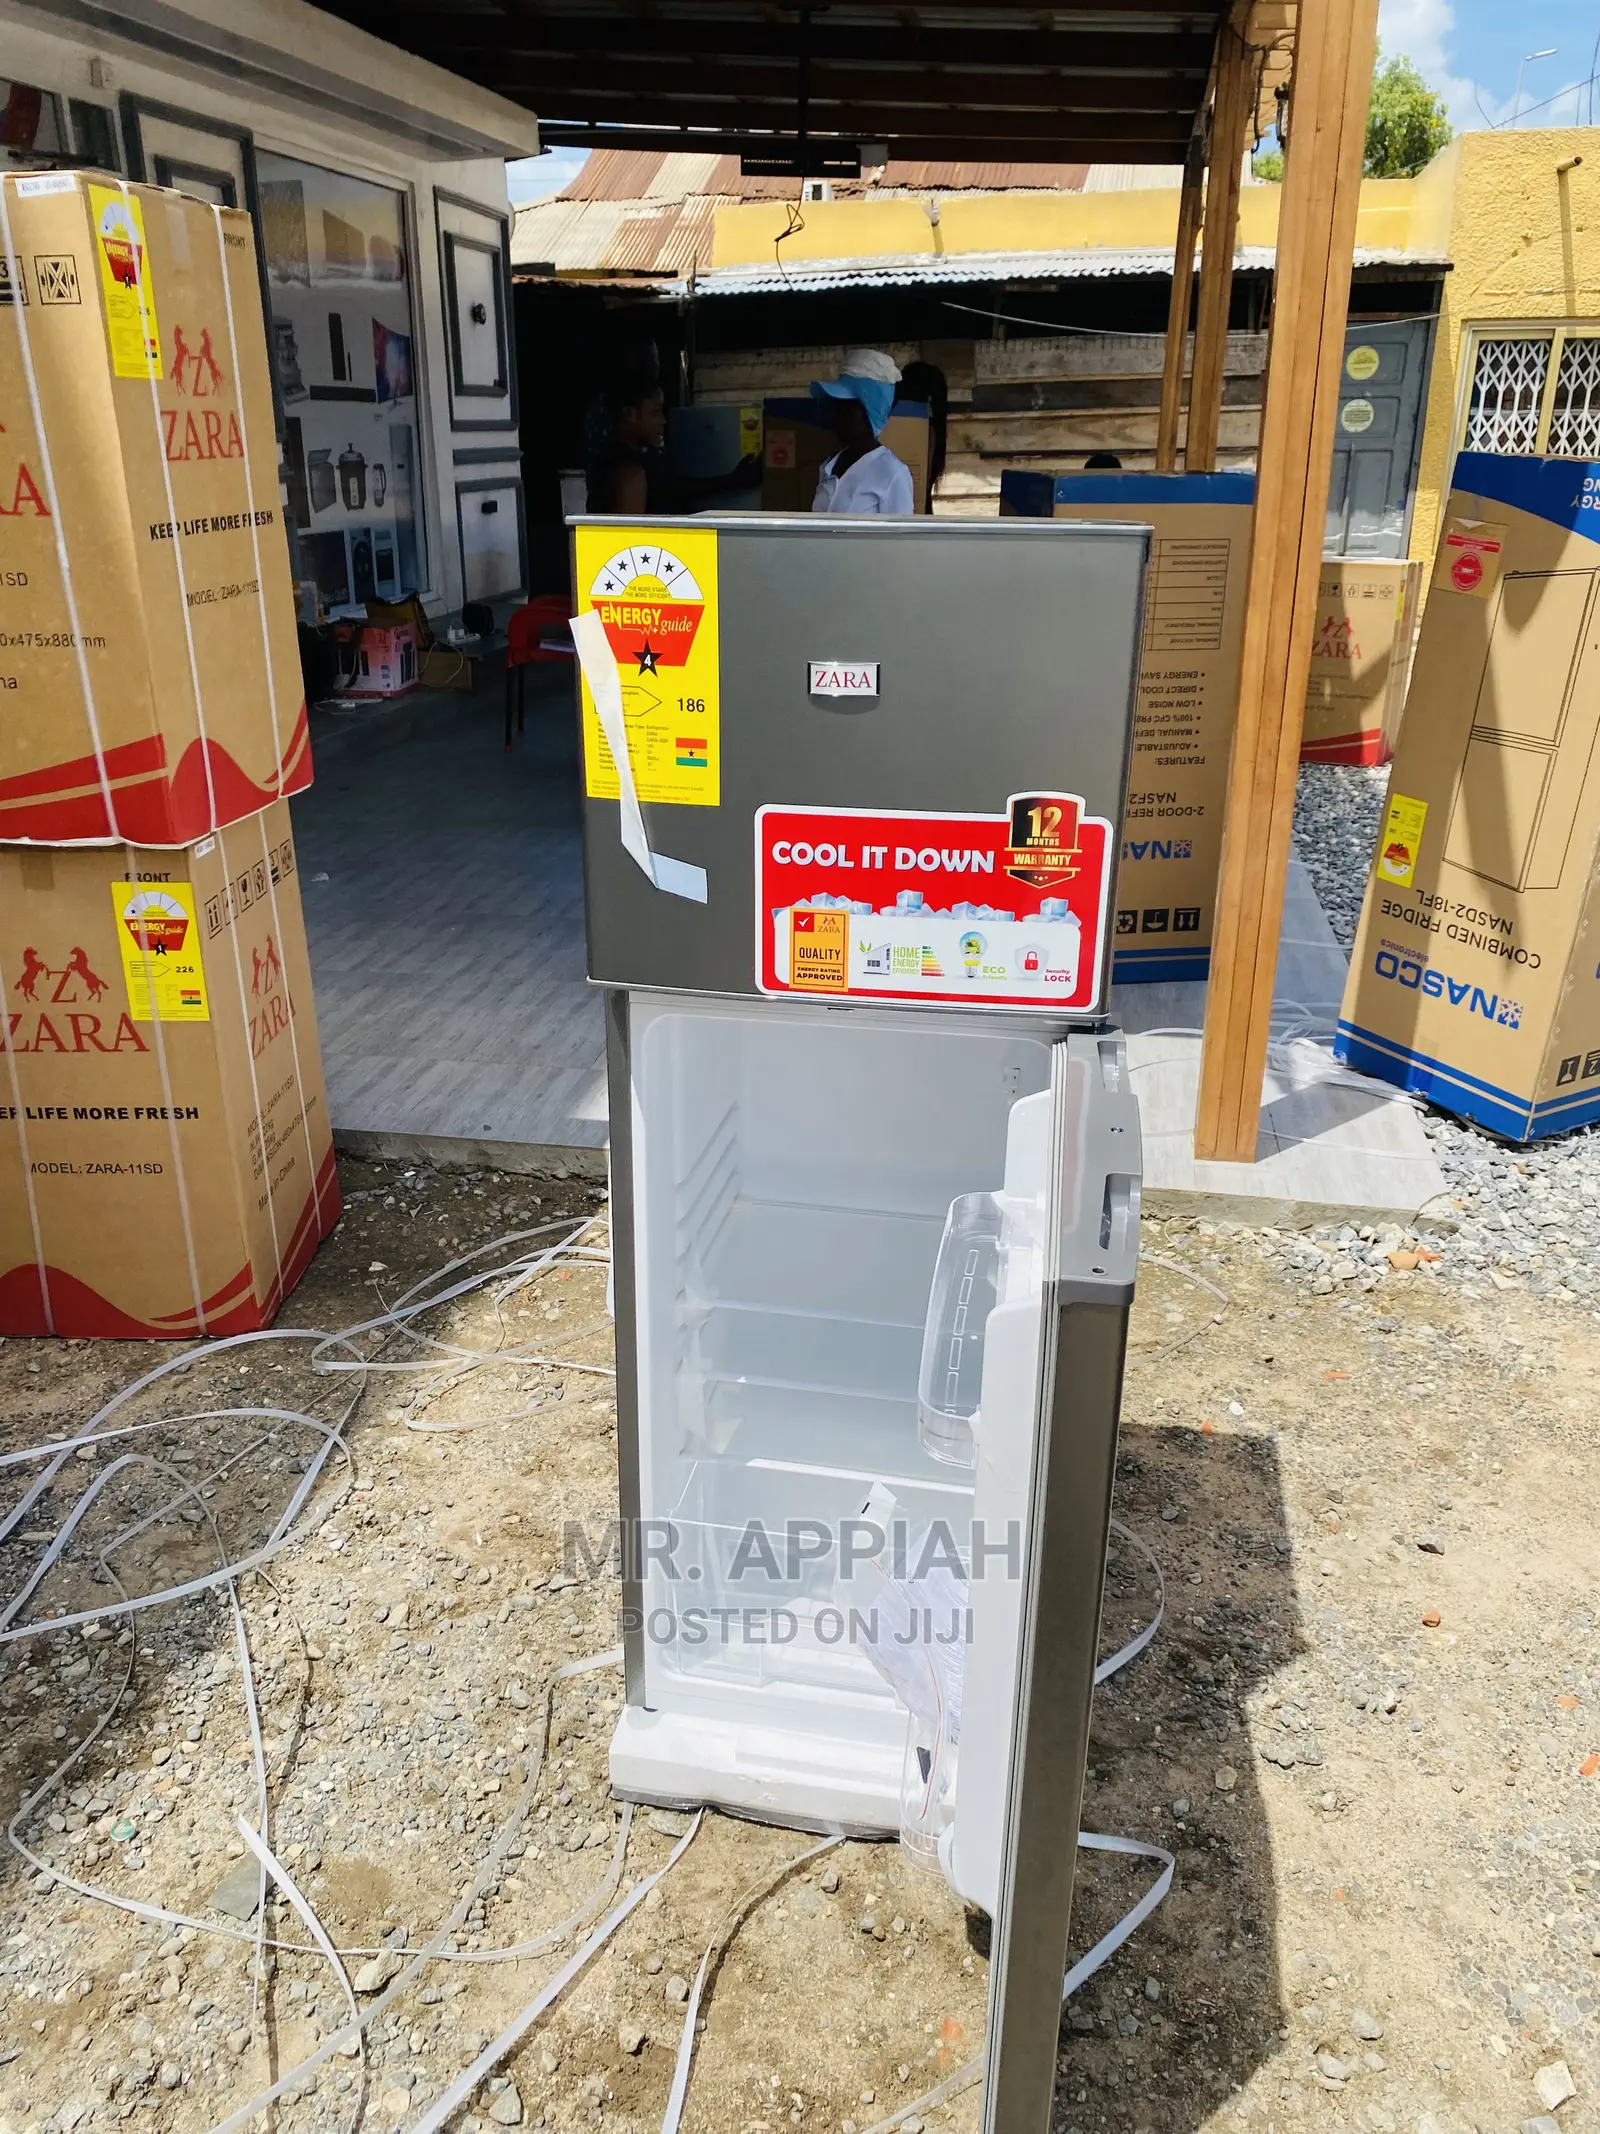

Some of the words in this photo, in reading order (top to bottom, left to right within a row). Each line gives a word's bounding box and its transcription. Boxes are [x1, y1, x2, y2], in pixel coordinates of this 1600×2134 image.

[160, 409, 244, 461] ZARA
[184, 518, 209, 536] LIFE
[211, 514, 240, 531] MORE
[600, 601, 662, 630] ENERGY
[660, 615, 693, 635] guide
[644, 654, 652, 666] 4
[815, 670, 872, 688] ZARA
[1163, 671, 1198, 679] ENERGY
[1165, 686, 1197, 694] DIRECT
[677, 698, 705, 713] 186
[1176, 700, 1196, 708] LOW
[1173, 714, 1193, 722] 100%
[1157, 728, 1193, 737] MANUAL
[1137, 742, 1192, 751] ADJUSTABLE
[1154, 756, 1206, 766] FEATURES:
[1157, 806, 1205, 817] 2-DOOR
[1027, 806, 1063, 838] 12
[1026, 837, 1060, 846] MONTHS
[772, 840, 855, 868] COOL
[861, 845, 888, 869] IT
[895, 847, 995, 874] DOWN
[1013, 853, 1072, 866] WARRANTY
[1381, 899, 1442, 933] FRIDGE
[1416, 889, 1513, 936] NASD2-18FL
[818, 925, 841, 934] ZARA
[893, 946, 921, 959] HOME
[1380, 938, 1430, 963] electronics
[1446, 924, 1542, 969] COMBINED
[799, 947, 841, 961] QUALITY
[892, 959, 920, 968] ENERGY
[982, 966, 1006, 974] ECO
[796, 972, 843, 982] APPROVED
[1044, 975, 1072, 983] LOCK
[1375, 951, 1499, 1021] NASCO
[248, 989, 297, 1060] ZARA
[0, 1011, 150, 1053] ZARA
[26, 1107, 68, 1119] LIFE
[73, 1107, 129, 1119] MORE
[135, 1107, 199, 1119] FRESH
[86, 1162, 163, 1174] ZARA-11SD
